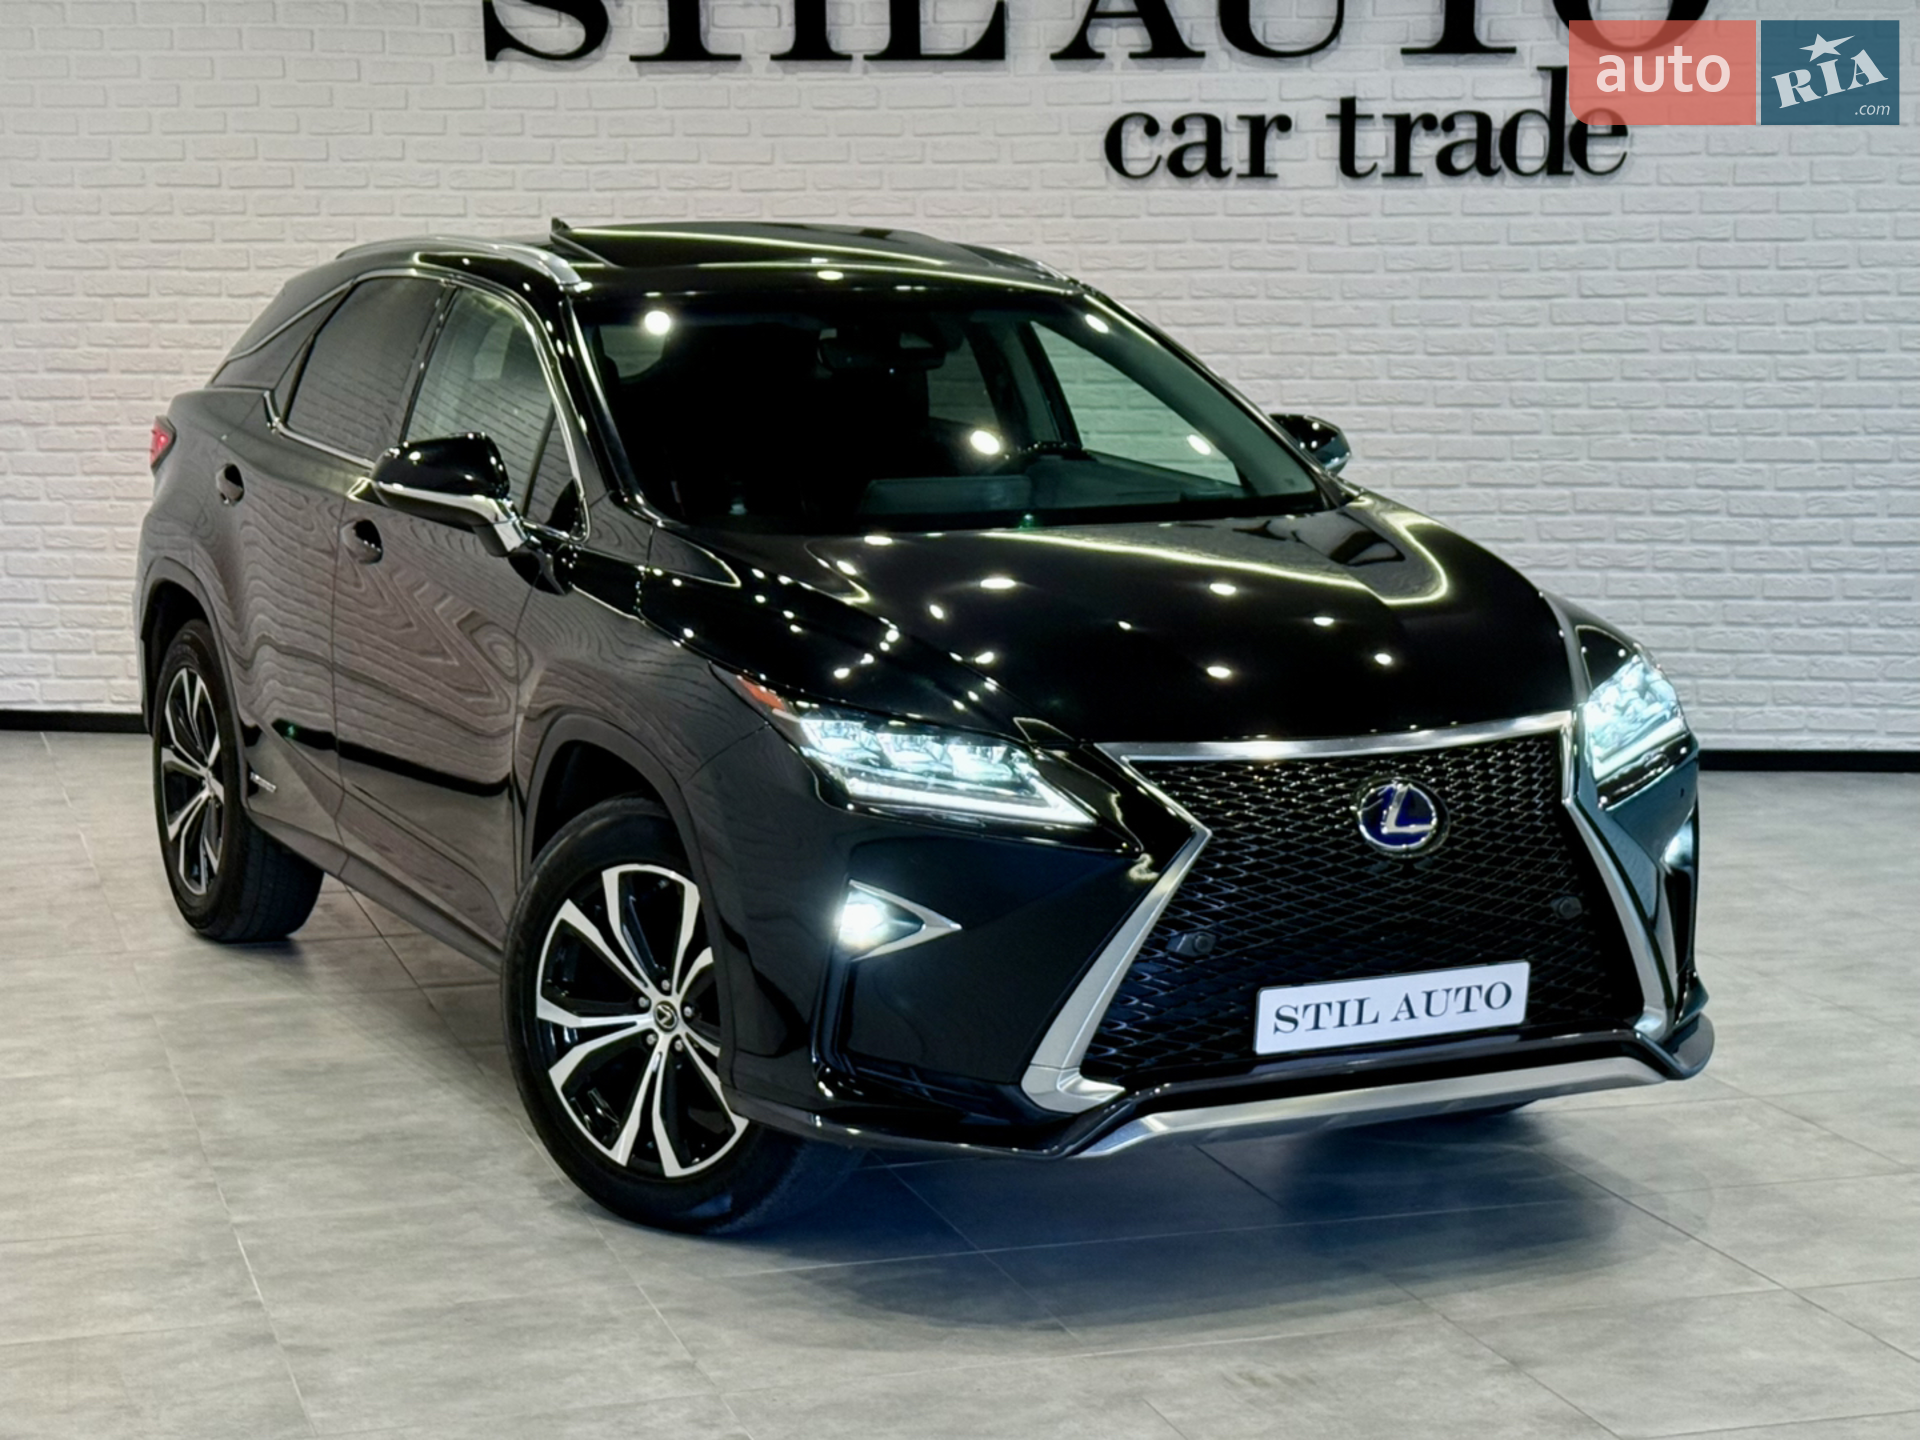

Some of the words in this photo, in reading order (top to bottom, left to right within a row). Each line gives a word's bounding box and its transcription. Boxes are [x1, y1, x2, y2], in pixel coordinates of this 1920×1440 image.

[1104, 111, 1293, 179] car
[1326, 65, 1629, 179] trade
[1273, 997, 1380, 1034] STIL
[1390, 981, 1513, 1022] AUTO
